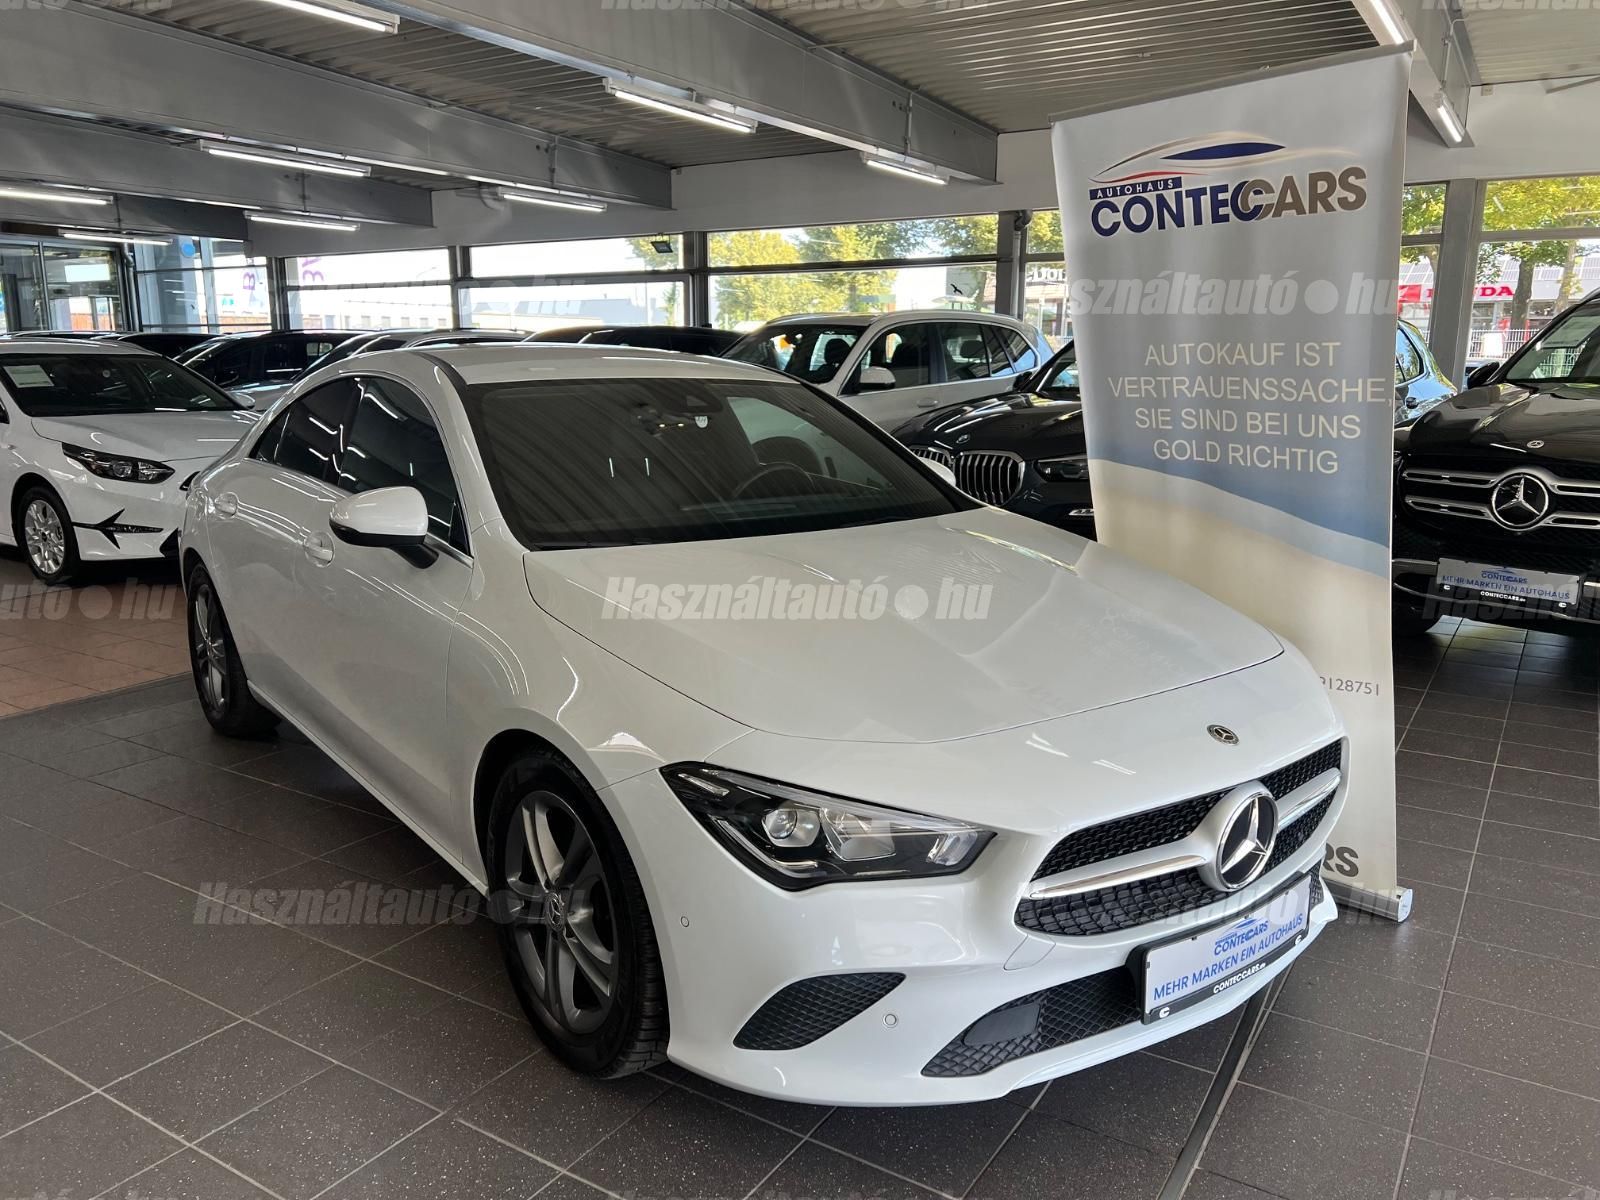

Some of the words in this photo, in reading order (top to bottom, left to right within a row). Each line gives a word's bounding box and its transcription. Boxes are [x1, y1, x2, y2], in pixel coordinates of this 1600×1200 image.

[1091, 166, 1368, 237] CONTECCARS
[1097, 179, 1175, 199] AUTOHAUS
[1145, 342, 1285, 367] AUTOKAUF
[1295, 342, 1342, 367] IST
[1108, 376, 1393, 406] VERTRAUENSSACHE,
[1135, 407, 1173, 430] SIE
[1181, 408, 1237, 432] SIND
[1247, 411, 1288, 436] BEI
[1298, 414, 1361, 439] UNS
[1153, 439, 1221, 463] GOLD
[1228, 443, 1339, 475] RICHTIG
[1442, 575, 1466, 585] MEHR
[1466, 579, 1502, 590] MARKEN
[1504, 584, 1518, 592] EIN
[1519, 587, 1570, 600] AUTOHAUS
[1154, 976, 1189, 1000] MEHR
[1192, 953, 1238, 985] MARKEN
[1241, 944, 1256, 962] EIN
[1258, 913, 1303, 953] AUTOHAUS
